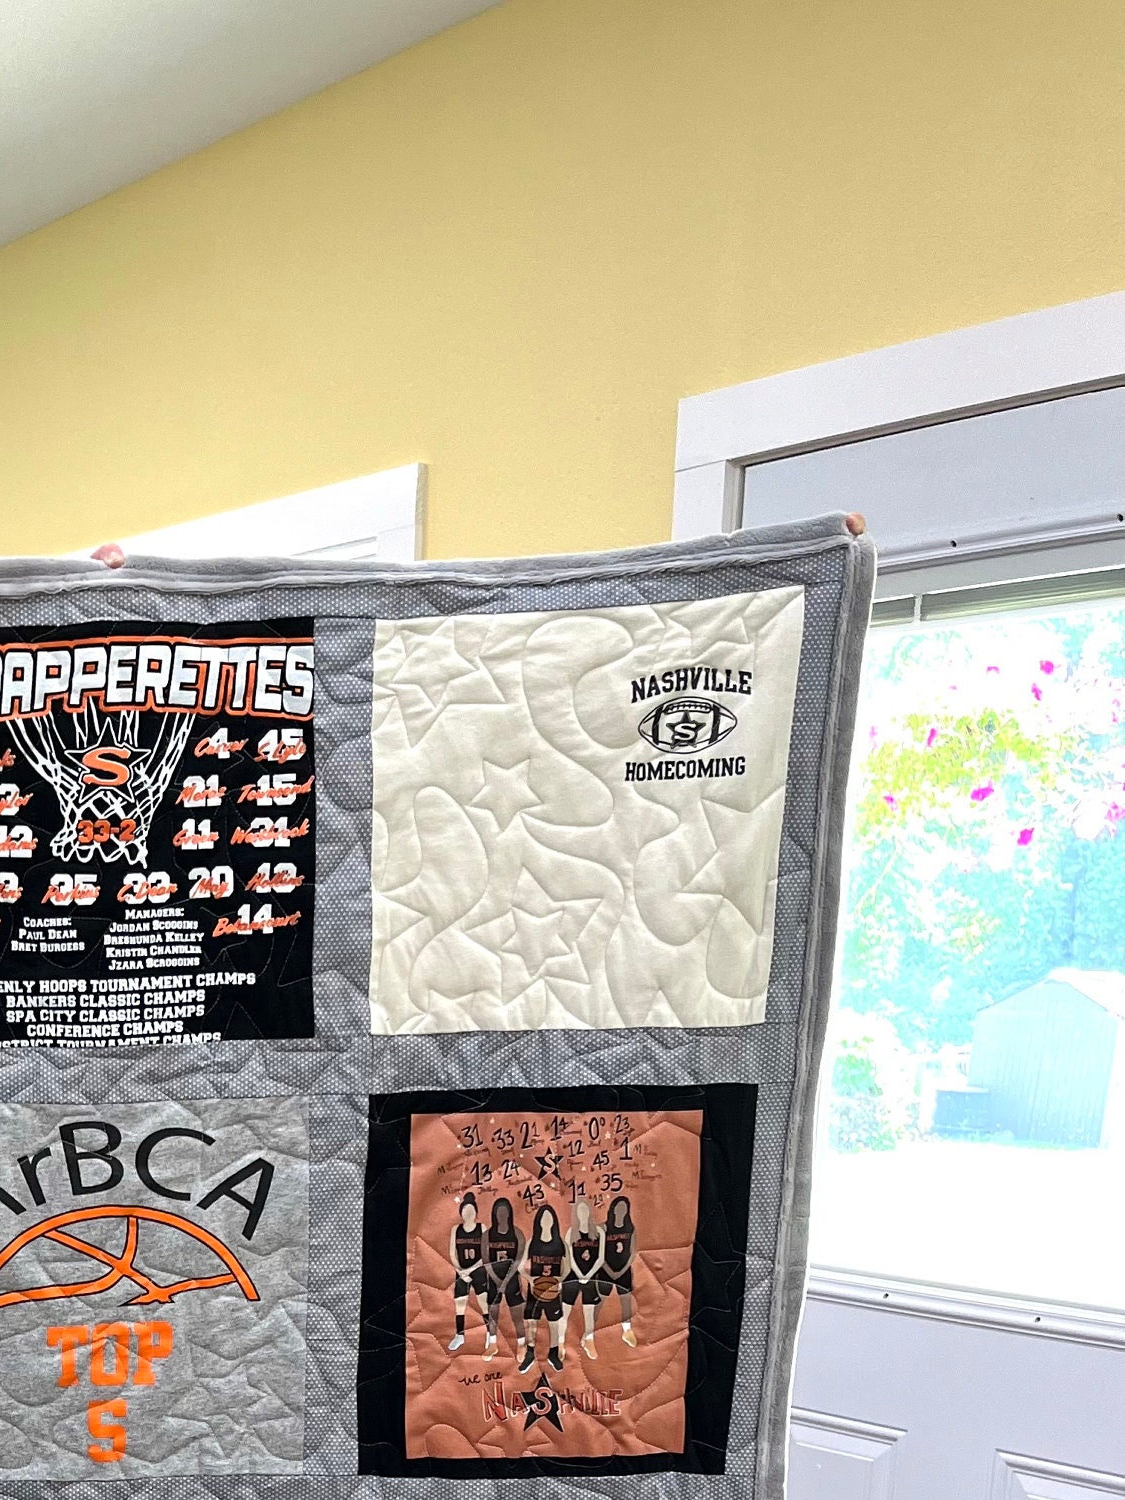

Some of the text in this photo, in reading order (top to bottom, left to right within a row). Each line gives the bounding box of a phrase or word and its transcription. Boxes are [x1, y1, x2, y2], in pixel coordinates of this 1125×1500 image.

[631, 666, 753, 703] NASHVILLE
[207, 727, 230, 759] 4
[82, 746, 132, 787] S
[625, 756, 746, 782] HOMECOMING
[256, 773, 297, 806] 15
[77, 819, 138, 845] 33-2
[188, 865, 234, 899] 20
[237, 903, 273, 935] 14
[39, 979, 87, 994] HOOPS
[90, 974, 193, 993] TOURNAMENT
[195, 971, 256, 988] CHAMPS
[6, 989, 205, 1009] BANKERS CLASSIC CHAMPS
[6, 1004, 205, 1023] SPA CITY CLASSIC CHAMPS
[26, 1020, 184, 1038] CONFERENCE CHAMPS
[46, 1320, 174, 1388] TOP
[86, 1398, 128, 1463] 5
